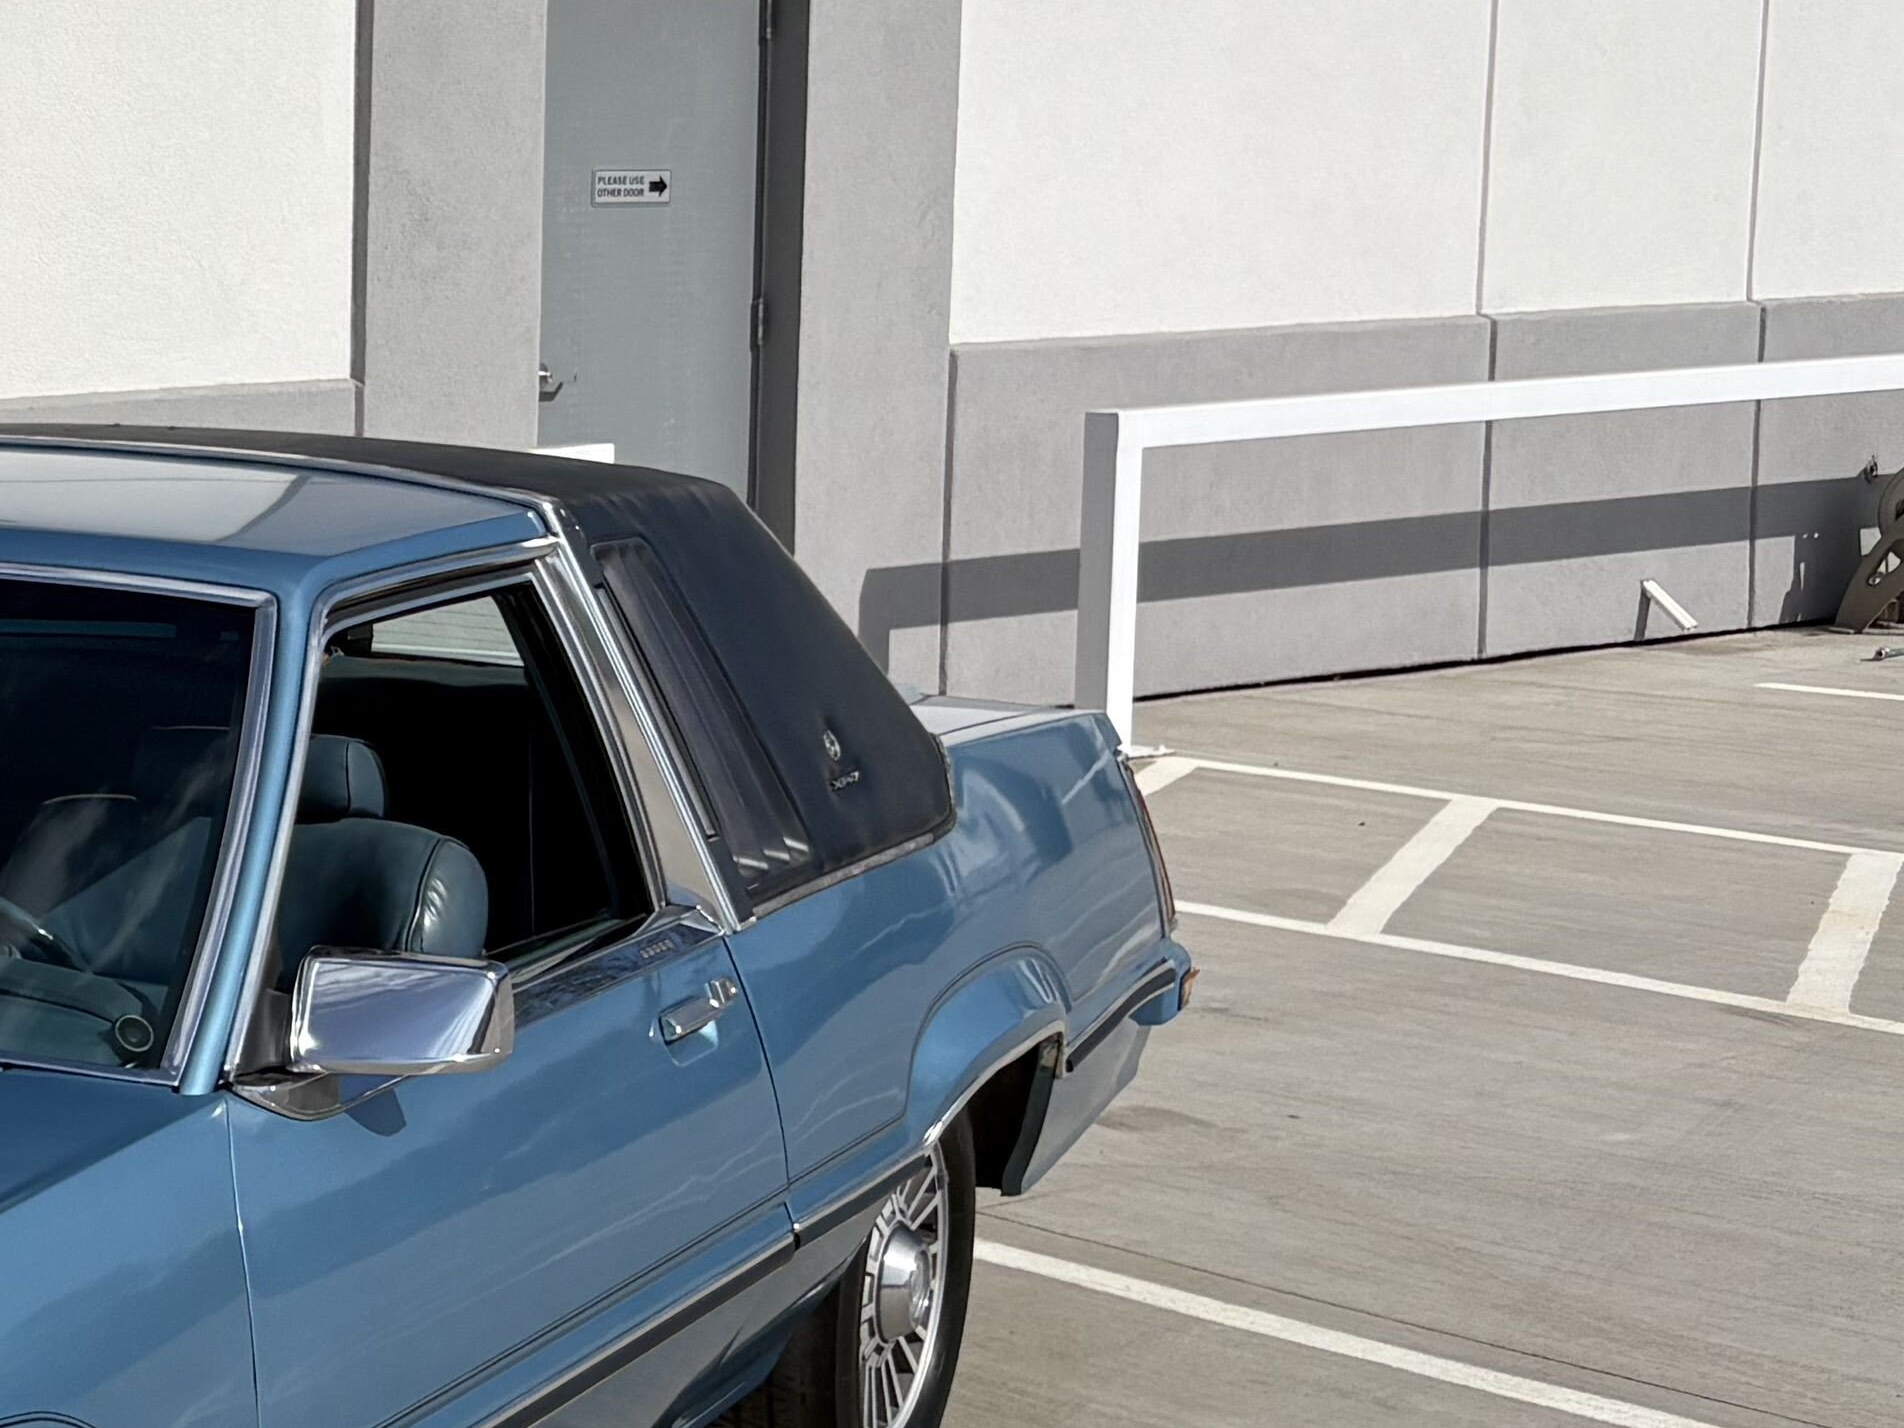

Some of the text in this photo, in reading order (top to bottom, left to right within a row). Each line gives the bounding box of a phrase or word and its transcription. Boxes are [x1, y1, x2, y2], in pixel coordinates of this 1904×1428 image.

[597, 175, 645, 186] PLEASE USE
[596, 188, 645, 198] OTHER DOOR
